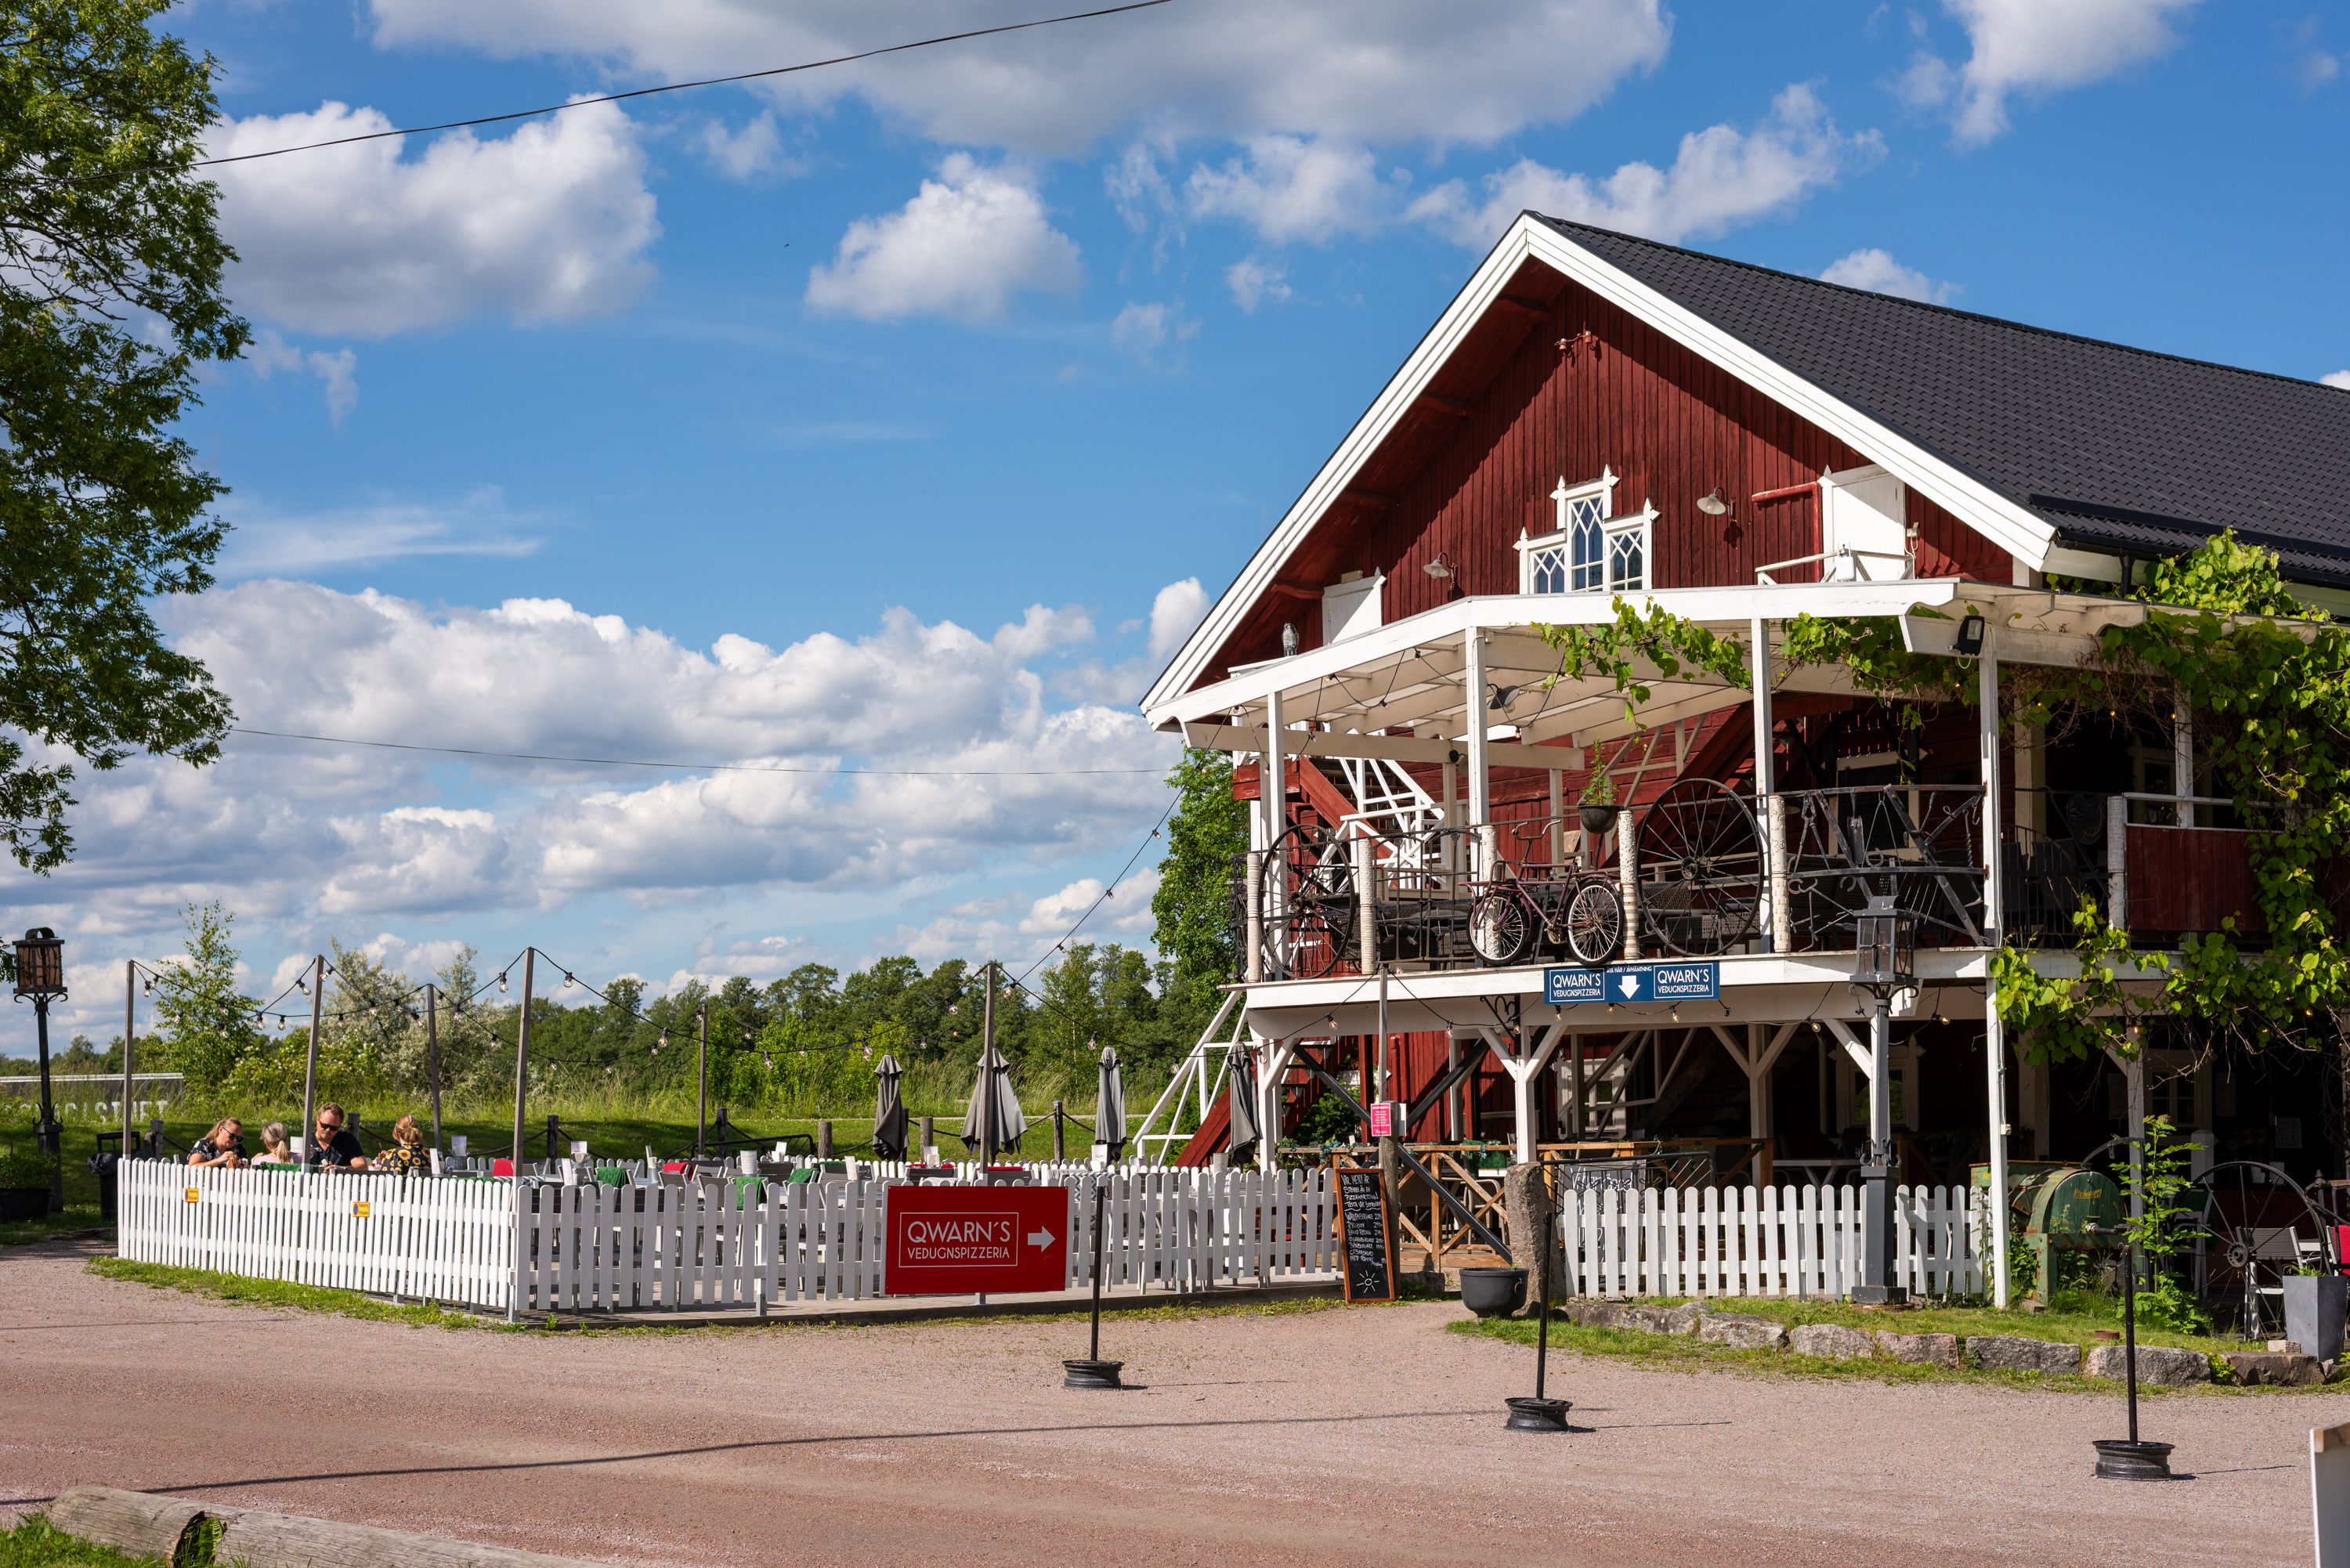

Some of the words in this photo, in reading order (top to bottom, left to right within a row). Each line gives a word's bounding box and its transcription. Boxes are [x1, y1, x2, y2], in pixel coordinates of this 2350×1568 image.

[1553, 988, 1601, 997] VEDUGNSPIZZERIA
[1658, 985, 1709, 993] VEDUGNSPIZZERIA
[907, 1247, 1010, 1259] VEDUGNSPIZZERIA
